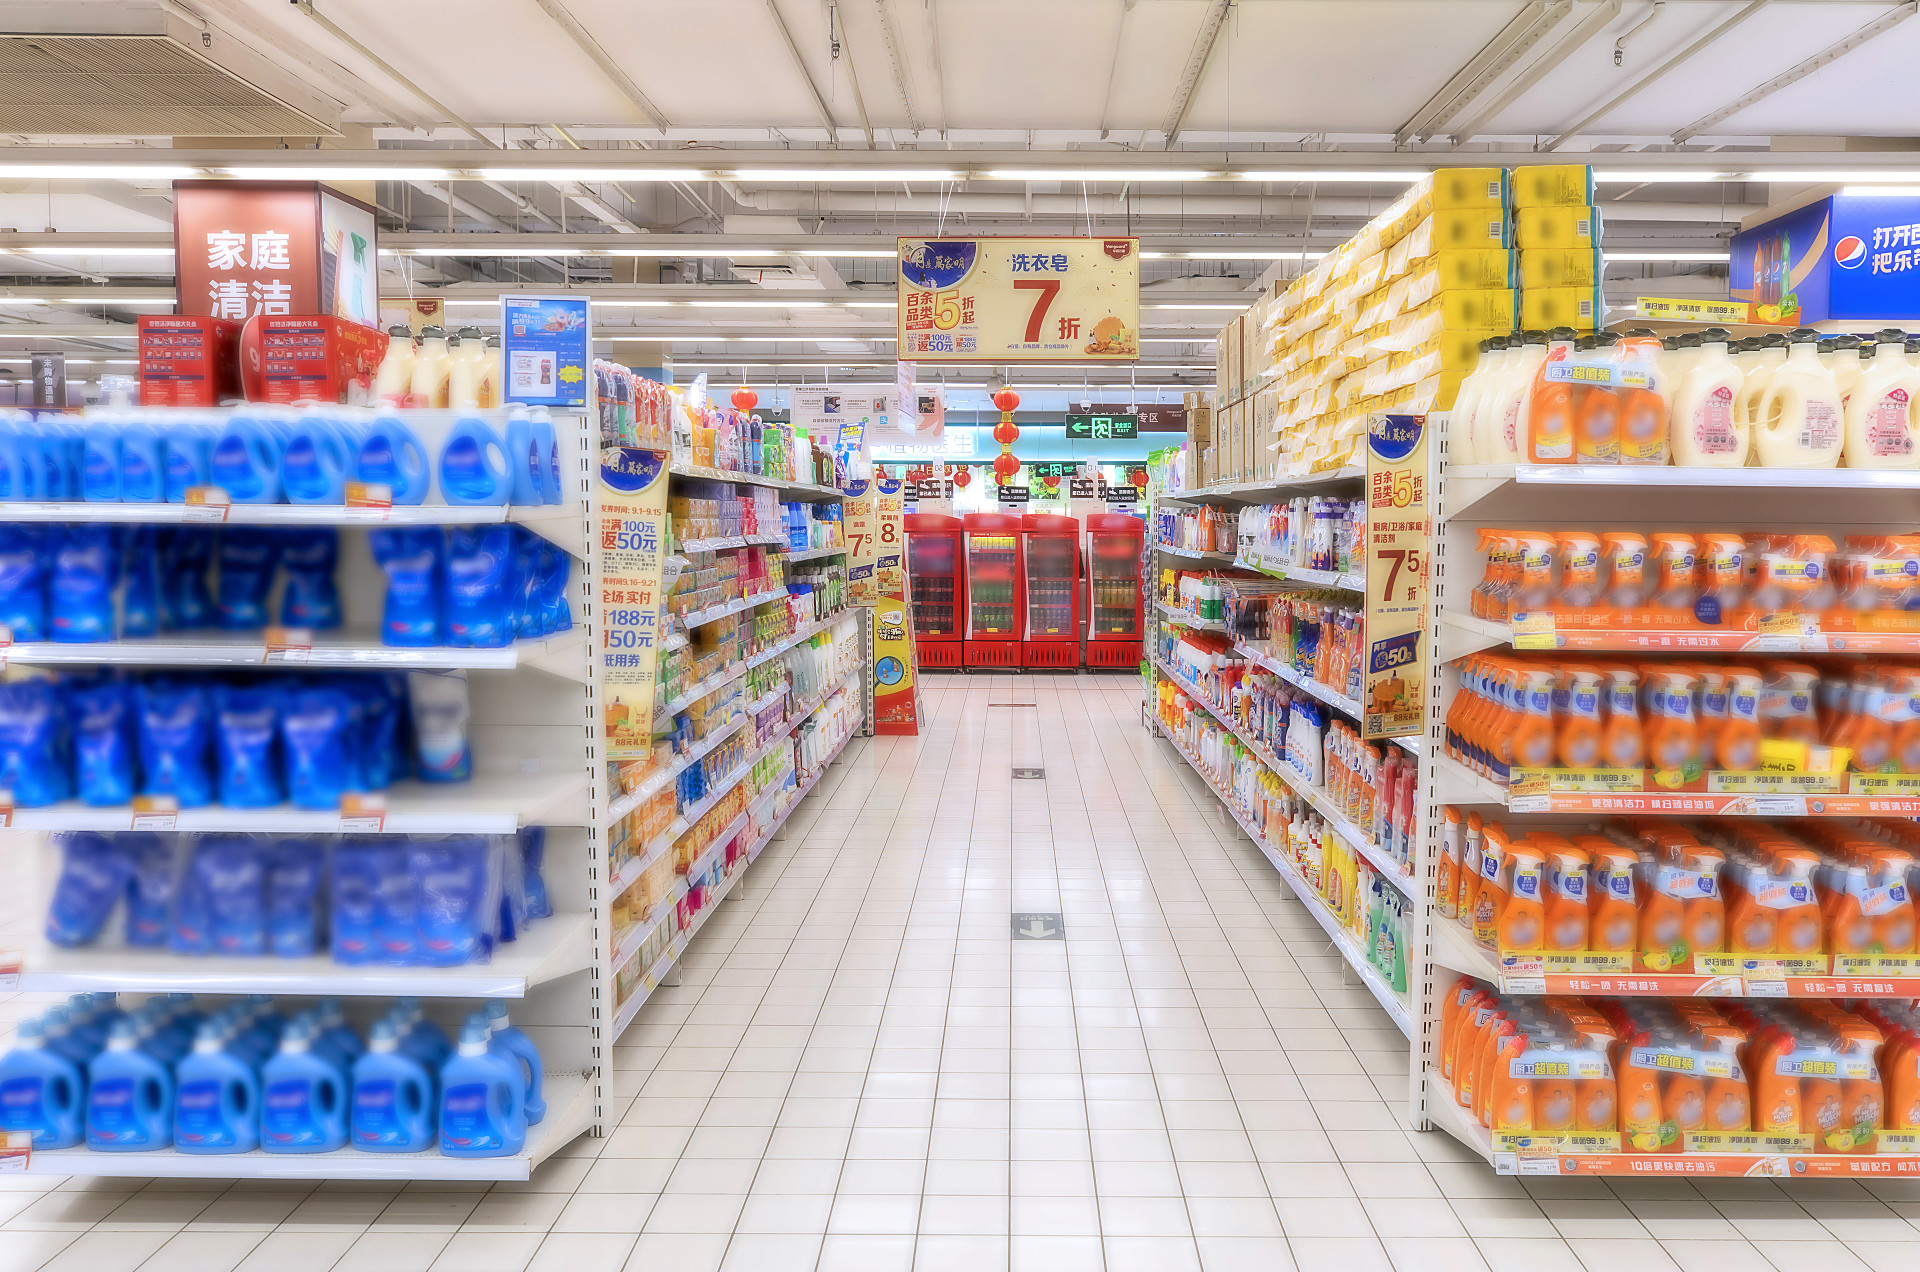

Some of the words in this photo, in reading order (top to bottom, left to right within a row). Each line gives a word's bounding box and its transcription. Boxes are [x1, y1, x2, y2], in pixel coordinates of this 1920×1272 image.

[206, 229, 291, 271] 家庭
[1012, 253, 1069, 272] 洗衣皂
[208, 279, 292, 320] 清洁
[907, 291, 933, 307] 百余
[1781, 299, 1795, 307] 亲和
[906, 306, 933, 322] 品类
[934, 289, 961, 331] 5
[962, 295, 975, 325] 折起
[1013, 279, 1061, 342] 7
[1058, 317, 1081, 340] 折
[1550, 365, 1611, 382] 厨卫超值装
[1138, 412, 1159, 423] 专区
[1373, 470, 1393, 486] 百余
[1372, 485, 1393, 500] 品类
[1393, 469, 1413, 508] 5
[1413, 475, 1423, 502] 折起
[632, 506, 662, 516] 9.1-9.15
[855, 500, 865, 516] 5
[888, 498, 897, 512] 5
[611, 519, 656, 534] 满100元
[880, 523, 895, 543] 8
[1372, 521, 1423, 533] 厨房/卫浴/家庭
[602, 531, 658, 550] 返50元
[847, 533, 864, 557] 7
[865, 533, 873, 544] 5
[1372, 533, 1396, 544] 清洁剂
[1407, 549, 1420, 573] 5
[1377, 549, 1406, 602] 7
[603, 590, 624, 605] 全场
[626, 590, 652, 605] 实付
[1407, 586, 1417, 601] 折
[1655, 614, 1691, 624] 无需过水
[1677, 636, 1720, 647] 无需过水
[1393, 712, 1420, 722] 88元礼包
[615, 738, 647, 747] 88元礼包
[1881, 765, 1897, 773] 亲和
[1896, 779, 1920, 788] 净味清
[1591, 799, 1645, 808] 更强清洁力
[1651, 799, 1715, 809] 横扫顽固油垢
[1569, 980, 1611, 990] 轻松一喷
[1617, 981, 1659, 991] 无需擦洗
[1804, 983, 1847, 993] 轻松一喷
[1853, 983, 1895, 993] 无需擦洗
[1514, 1062, 1570, 1076] 厨卫超值装
[1635, 1052, 1695, 1071] 厨卫超值装
[1781, 1060, 1837, 1074] 厨卫超值装
[1659, 1125, 1675, 1134] 亲和
[1854, 1127, 1870, 1135] 亲和
[1850, 1161, 1891, 1172] 革新配方
